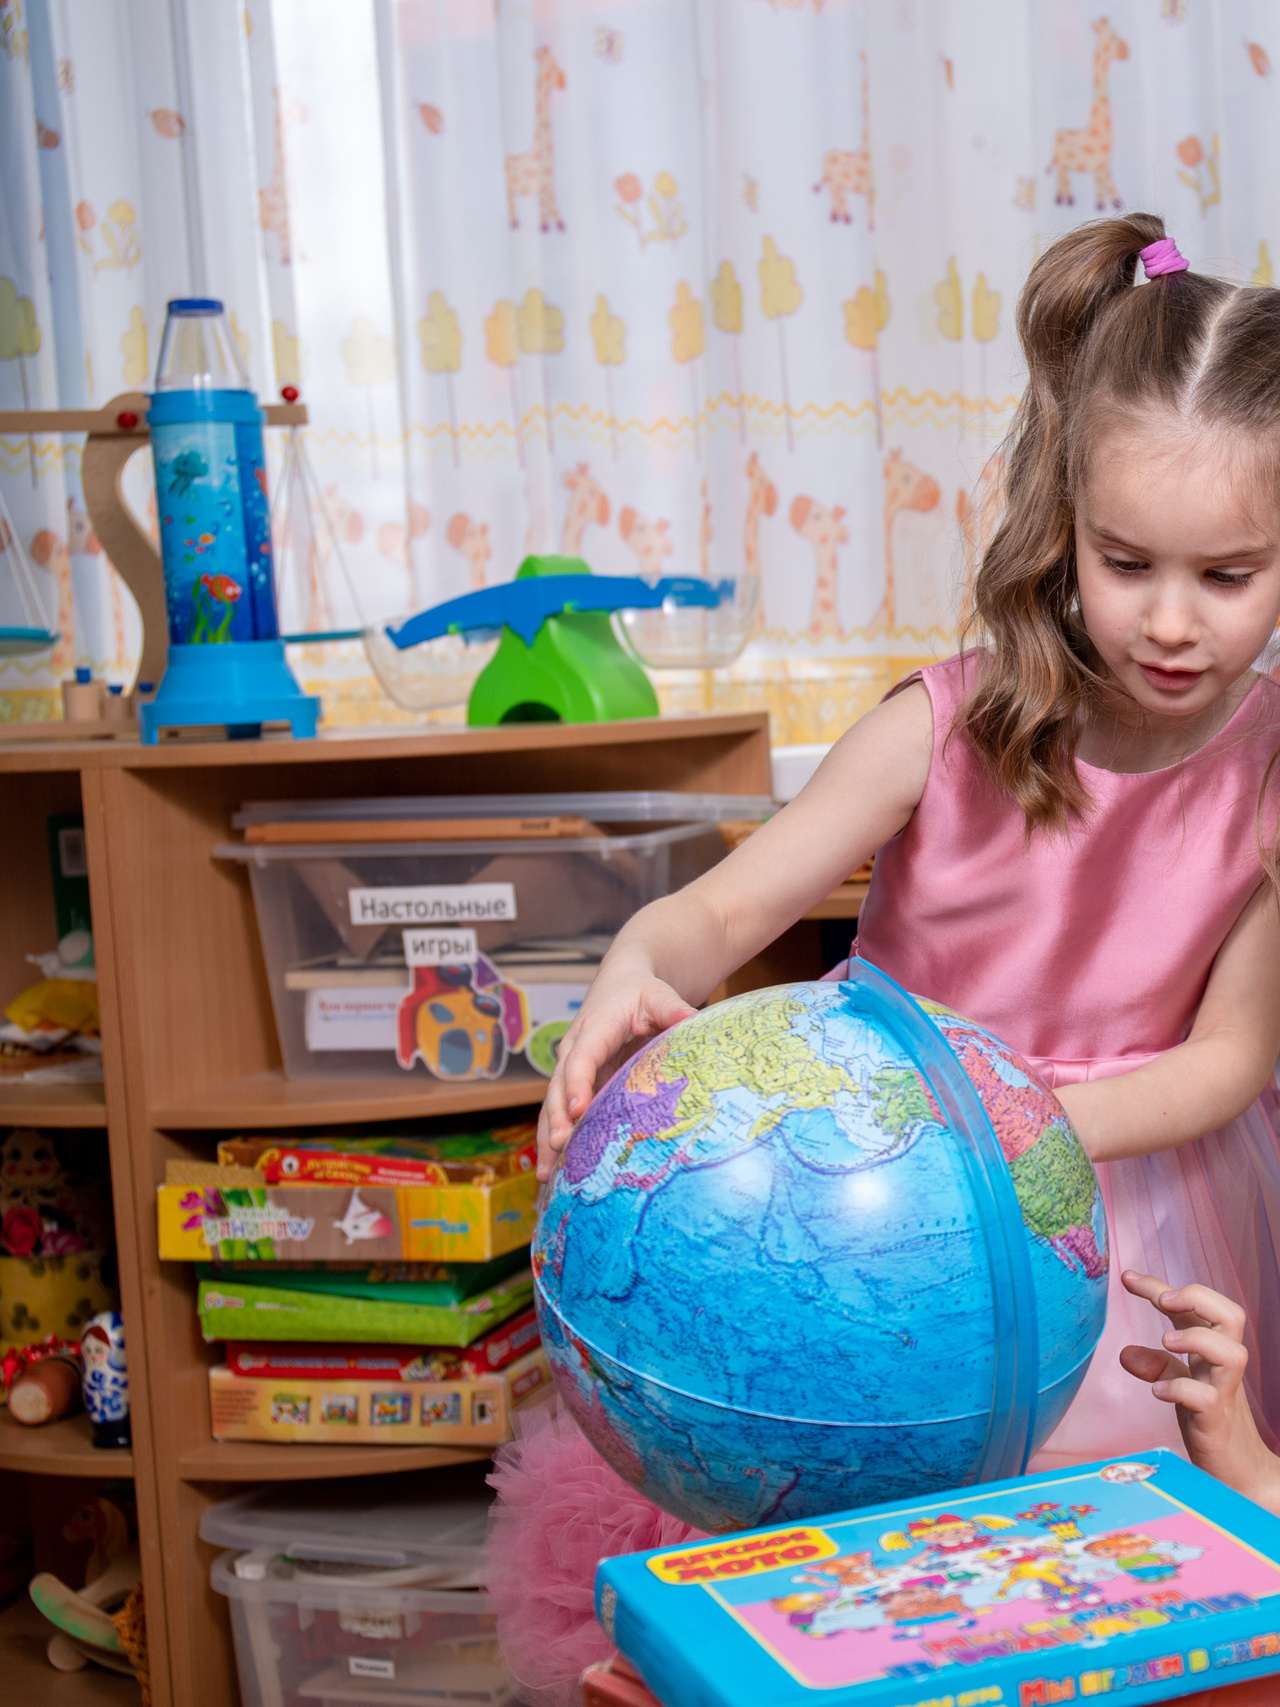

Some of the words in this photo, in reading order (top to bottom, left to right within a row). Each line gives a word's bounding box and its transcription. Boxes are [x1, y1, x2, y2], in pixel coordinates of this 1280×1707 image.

[360, 897, 508, 919] Настольные
[411, 936, 471, 960] игры
[663, 1531, 812, 1570] ДЕТСКОЕ
[677, 1545, 821, 1582] ЛОТО
[1079, 1653, 1185, 1697] ИГРАЕМ
